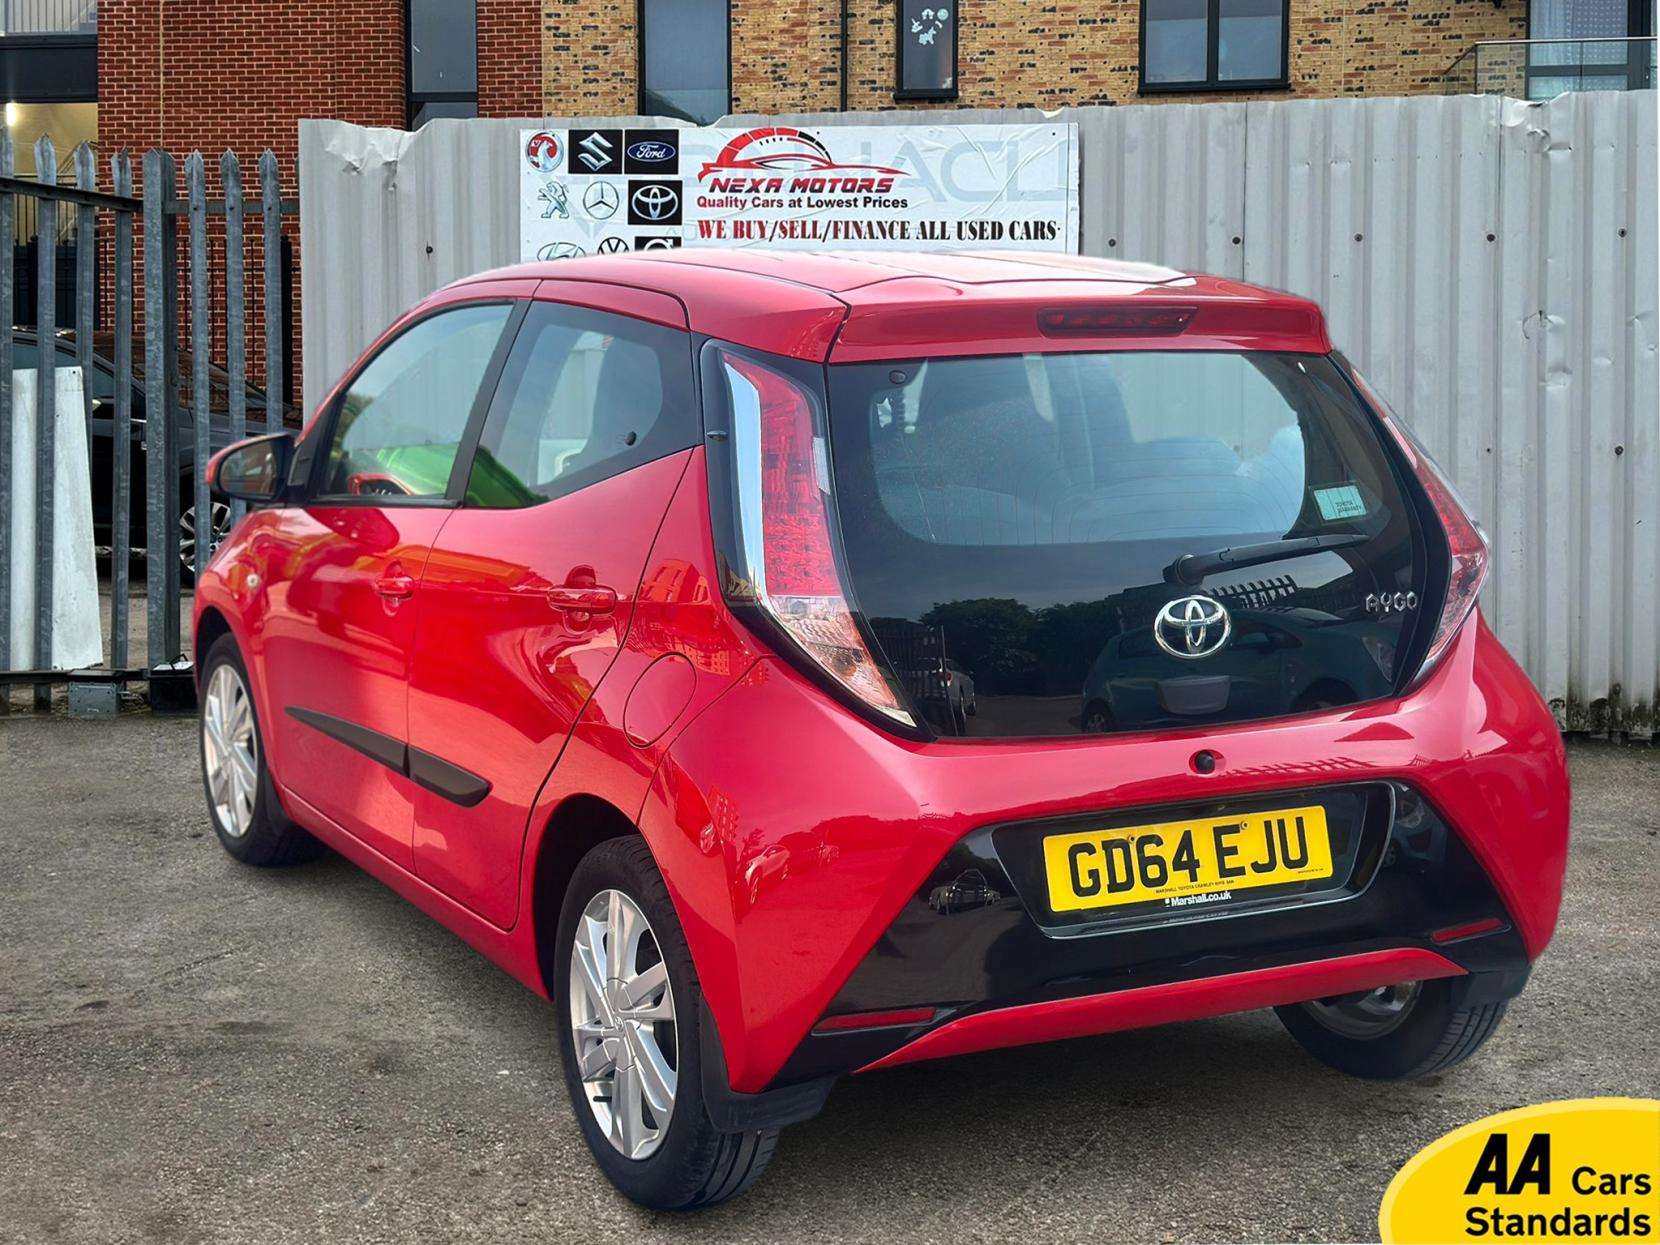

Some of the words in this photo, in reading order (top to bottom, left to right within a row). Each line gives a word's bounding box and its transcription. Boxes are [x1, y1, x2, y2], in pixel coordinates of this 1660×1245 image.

[636, 144, 666, 158] Ford
[709, 178, 784, 193] NEXA
[789, 178, 894, 193] MOTORS
[697, 196, 747, 210] Quality
[751, 196, 784, 208] Cars
[788, 197, 802, 208] at
[807, 196, 858, 208] Lowest
[863, 196, 908, 208] Prices
[697, 220, 726, 239] WE
[916, 220, 950, 240] ALL
[957, 220, 1004, 240] USED
[1009, 220, 1057, 240] CARS
[1365, 591, 1417, 613] AYGO
[1067, 829, 1201, 898] GD64
[1212, 816, 1310, 879] EJU
[1170, 891, 1232, 907] Marshall.co.uk
